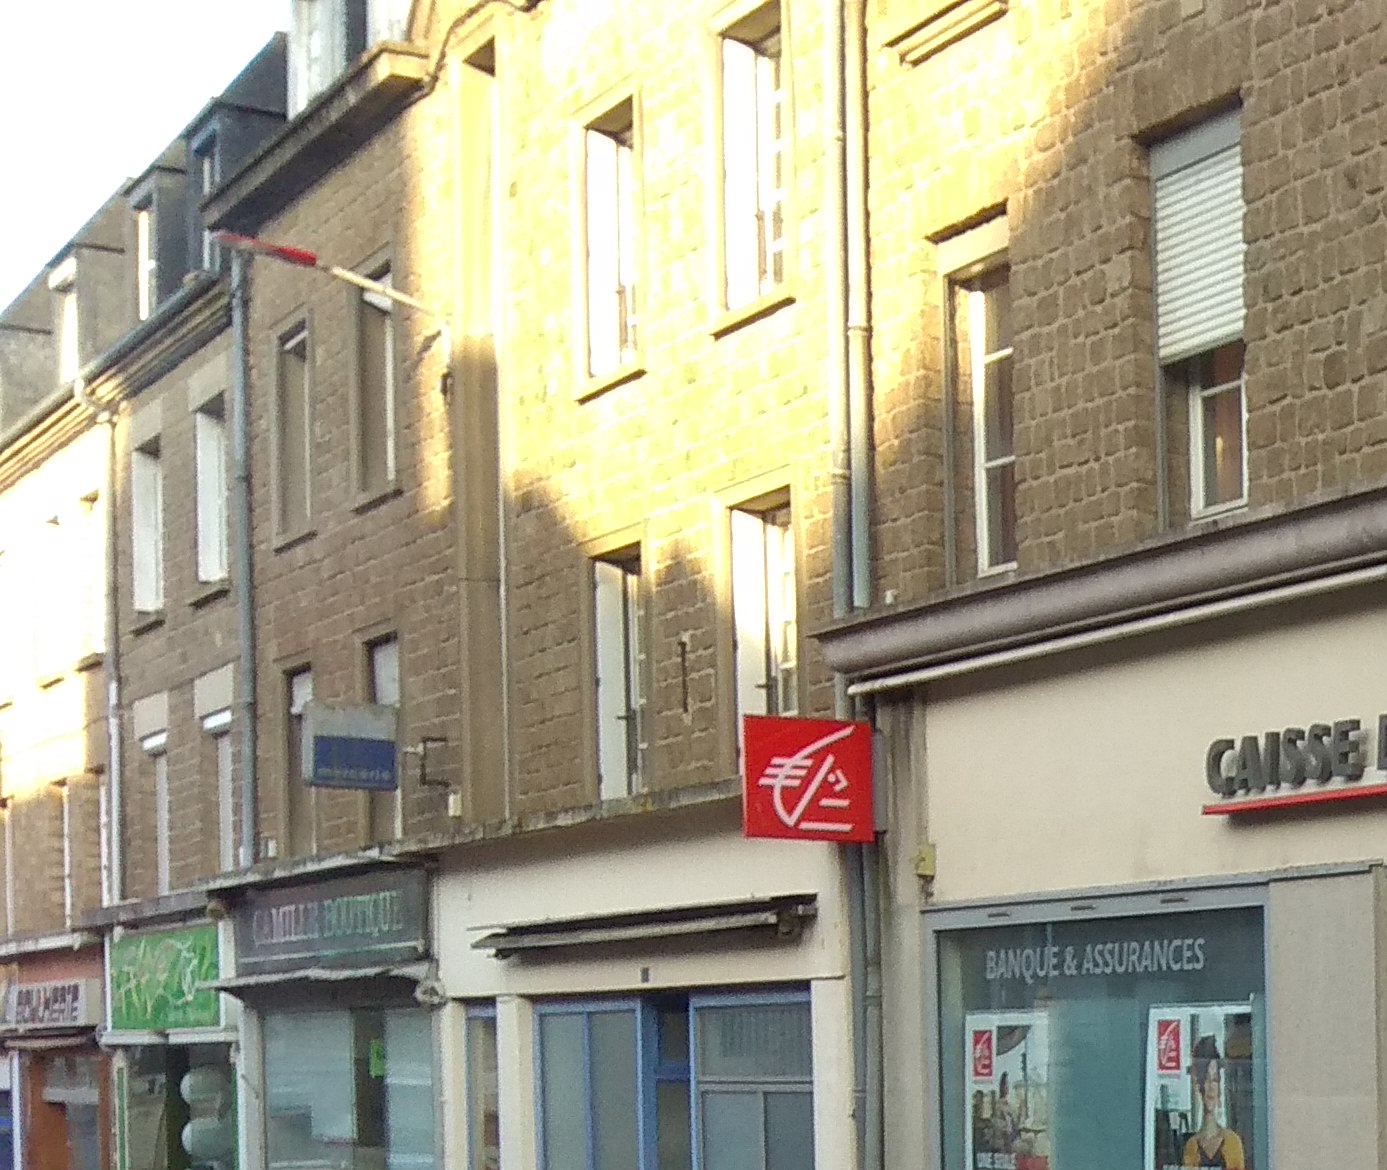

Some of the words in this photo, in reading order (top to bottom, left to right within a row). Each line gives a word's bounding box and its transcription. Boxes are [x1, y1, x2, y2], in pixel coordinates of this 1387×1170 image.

[1205, 717, 1363, 797] CAISSE
[323, 890, 402, 937] BOUTIQUE
[986, 946, 1060, 985] BANQUE
[1063, 946, 1078, 976] &
[1081, 937, 1205, 976] ASSURANCES
